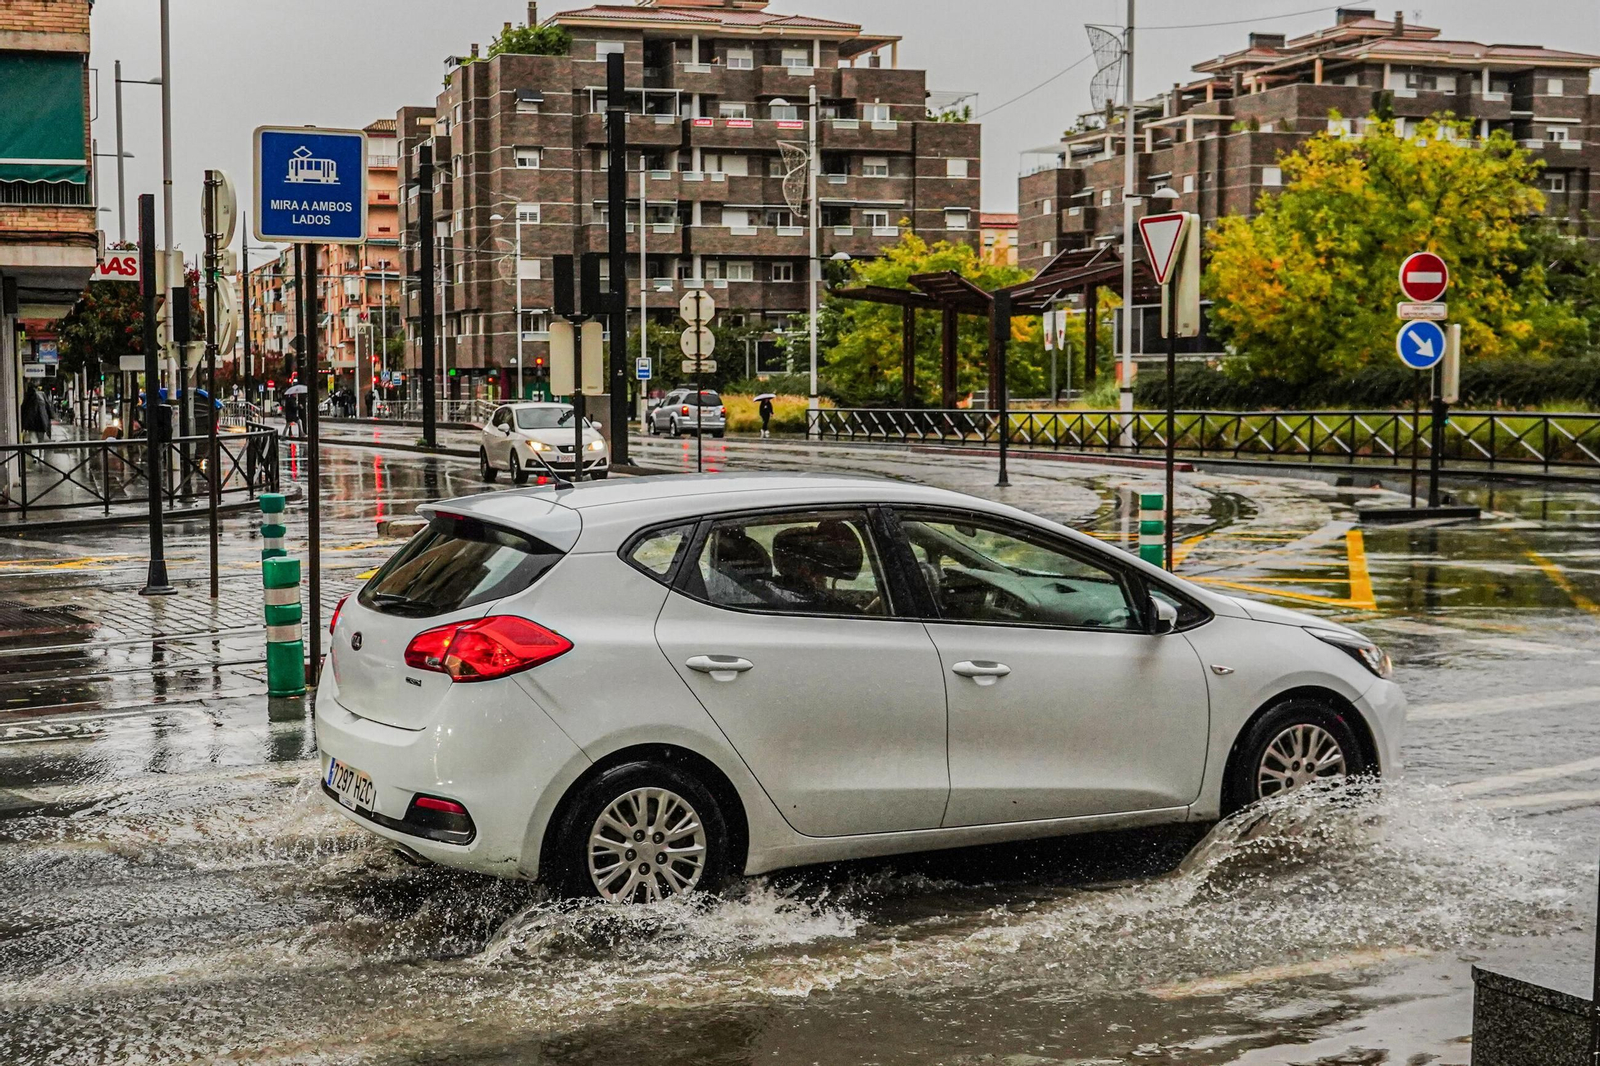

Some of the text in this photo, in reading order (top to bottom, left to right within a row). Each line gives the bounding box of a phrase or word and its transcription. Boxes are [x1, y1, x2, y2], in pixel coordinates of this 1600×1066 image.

[271, 199, 352, 212] MIRA A AMBOS
[292, 214, 331, 225] LADOS
[332, 762, 373, 805] 7297 HZC
